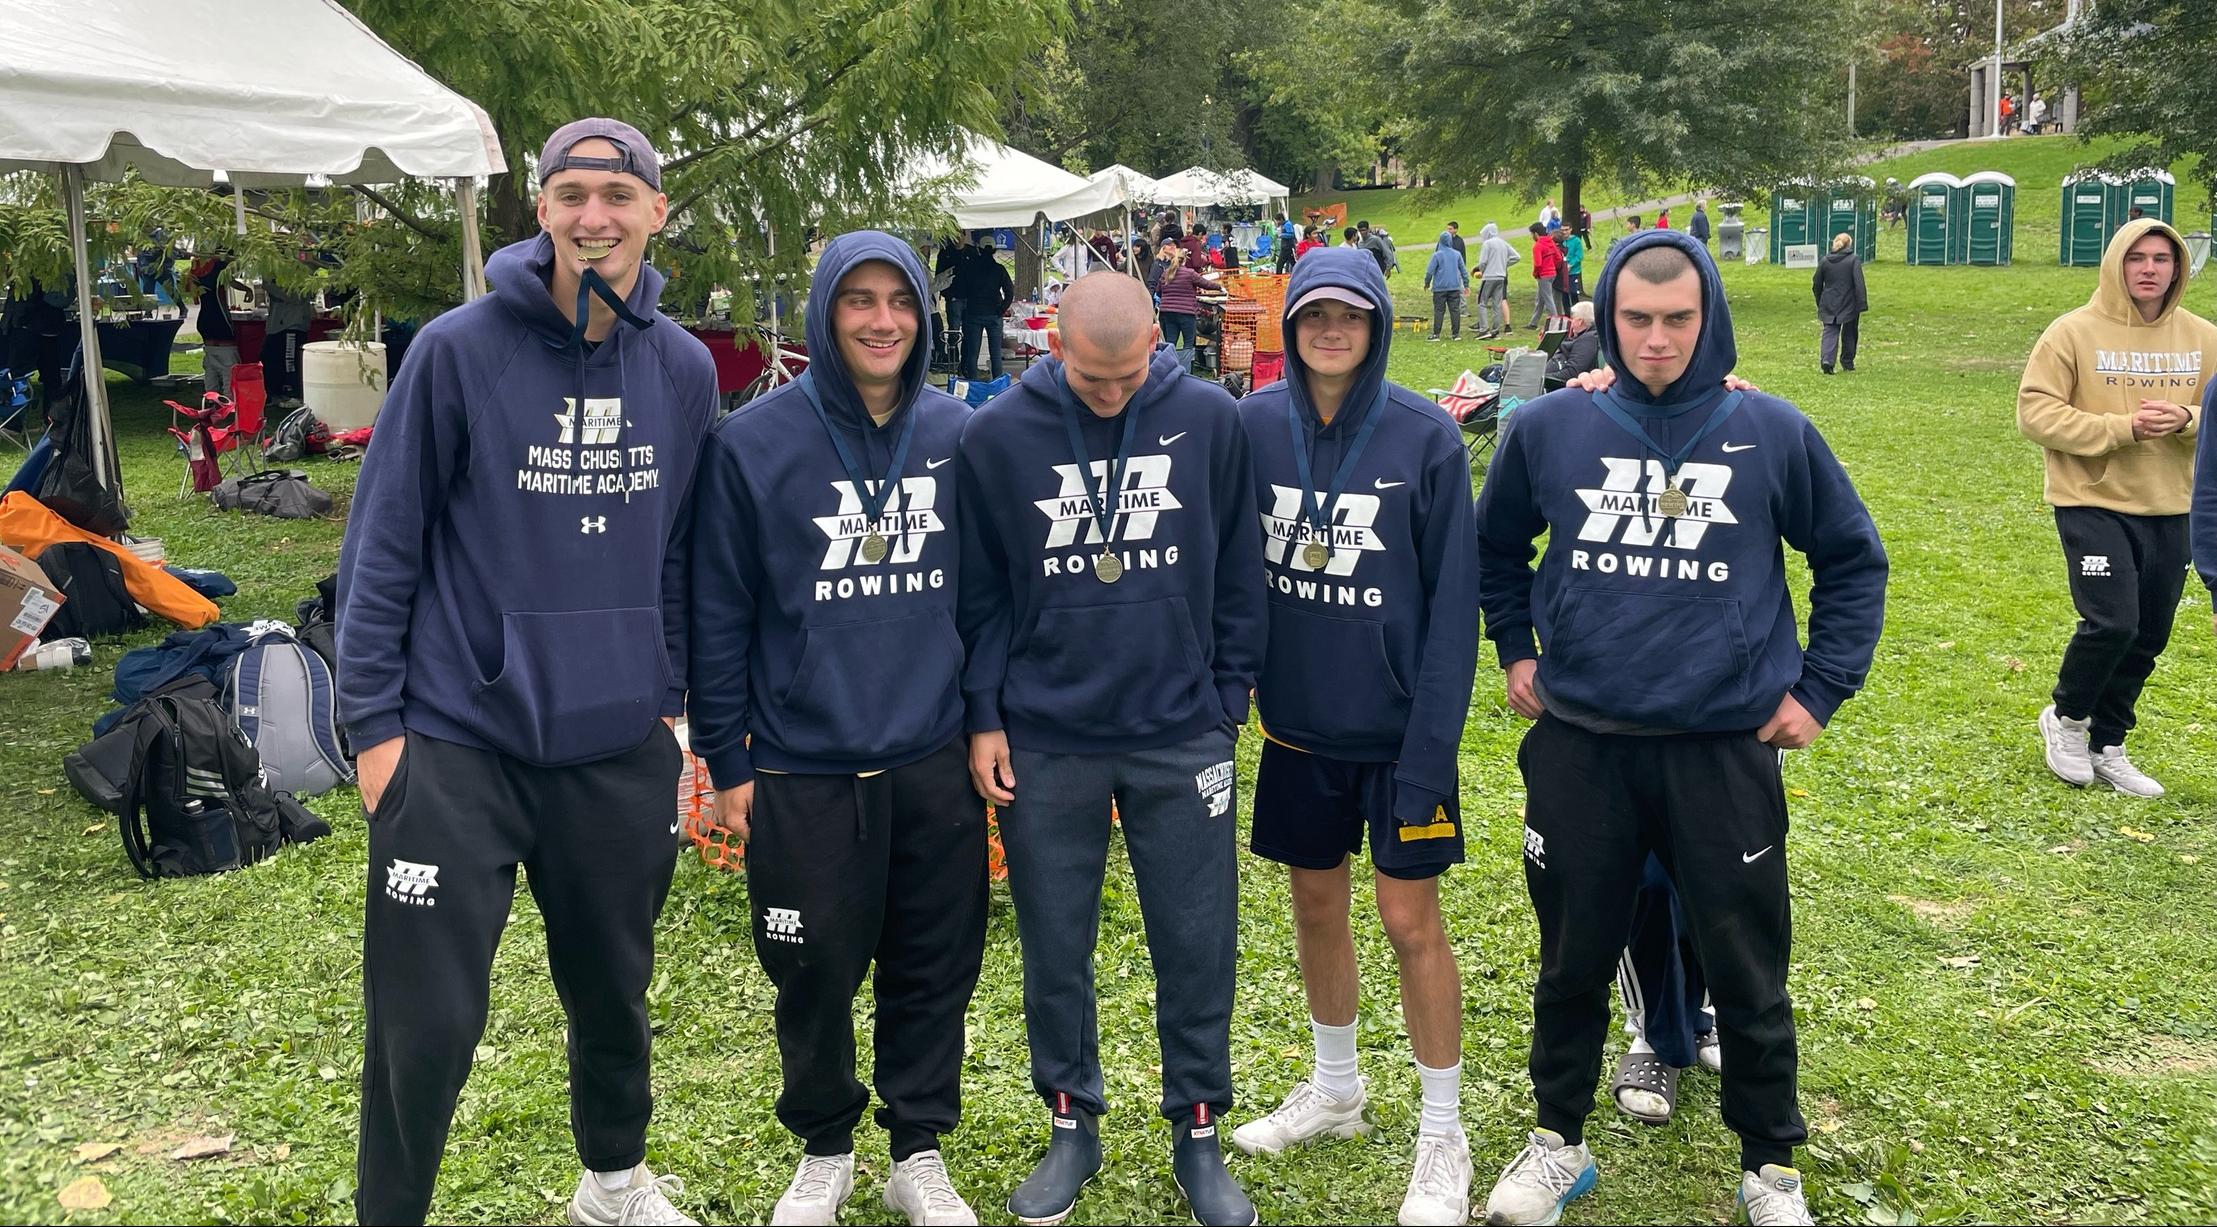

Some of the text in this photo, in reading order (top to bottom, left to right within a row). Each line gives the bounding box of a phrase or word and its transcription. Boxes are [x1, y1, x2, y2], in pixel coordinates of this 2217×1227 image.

[2096, 350, 2202, 373] MARITIME
[2106, 376, 2197, 388] ROWING
[517, 469, 592, 495] MARITIME
[1571, 549, 1729, 582] ROWING
[815, 568, 944, 601] ROWING
[1264, 567, 1383, 607] ROWING
[392, 871, 429, 885] MARITIME
[385, 886, 436, 907] ROWING
[766, 931, 804, 944] ROWING
